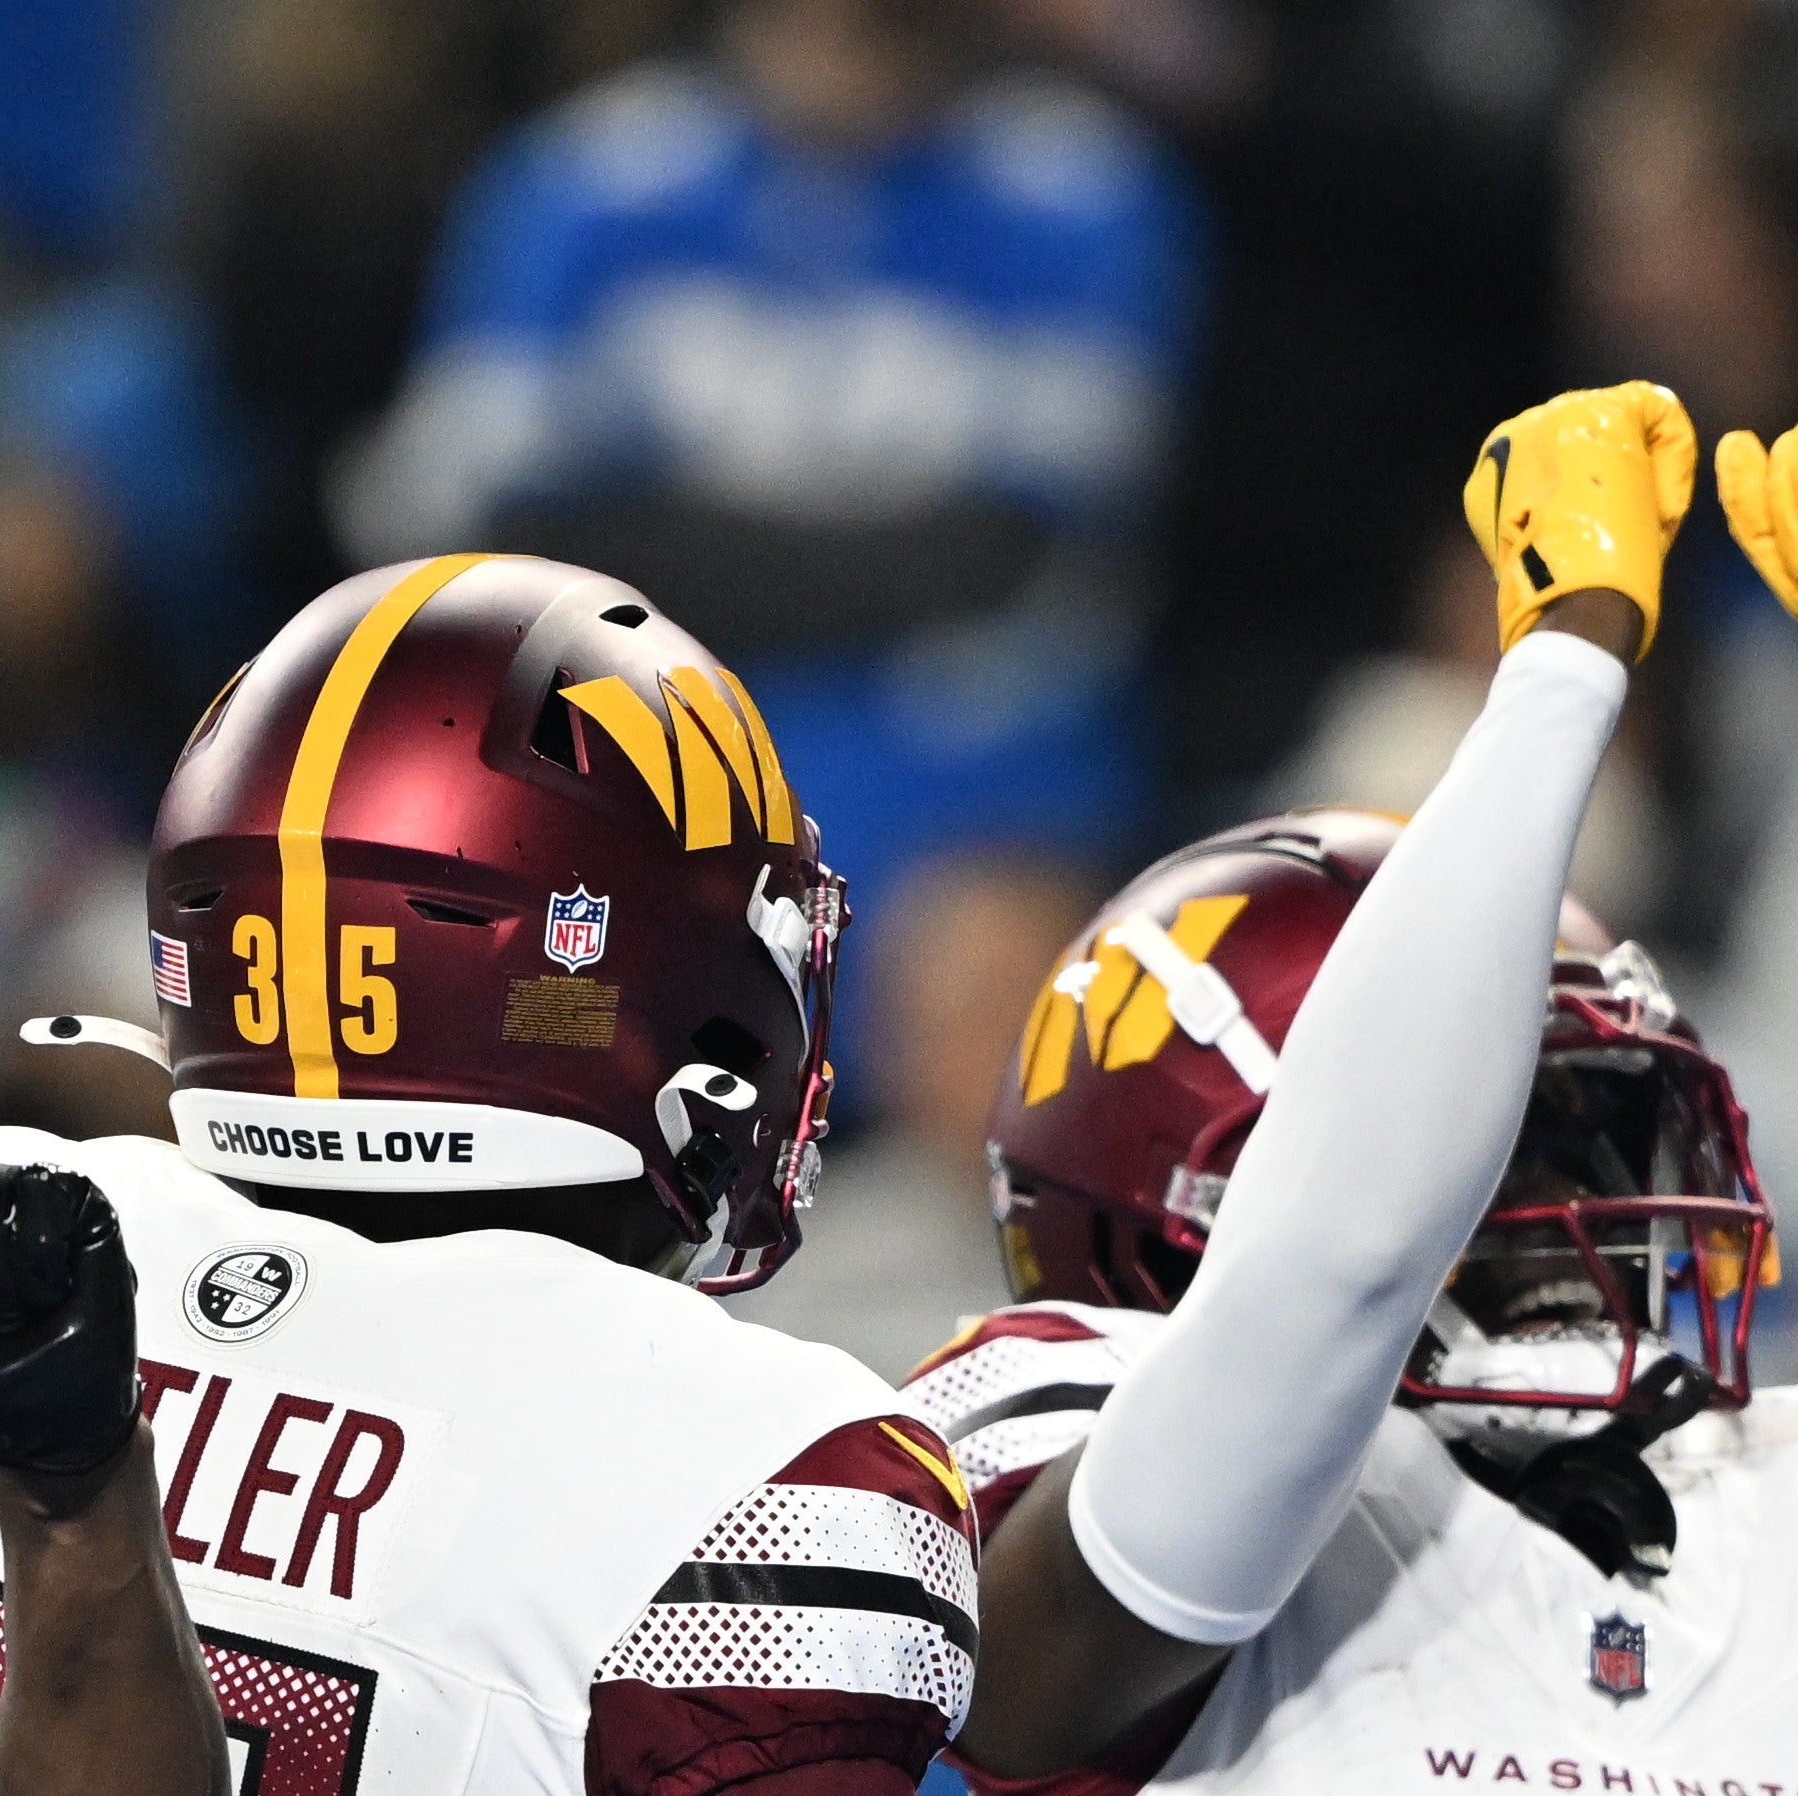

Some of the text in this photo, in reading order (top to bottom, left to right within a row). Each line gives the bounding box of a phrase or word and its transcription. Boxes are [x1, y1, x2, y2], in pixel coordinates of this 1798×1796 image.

[554, 923, 596, 957] NFL
[208, 1120, 474, 1163] CHOOSE LOVE
[210, 1270, 280, 1303] COMMANDERS
[233, 1301, 252, 1316] 32
